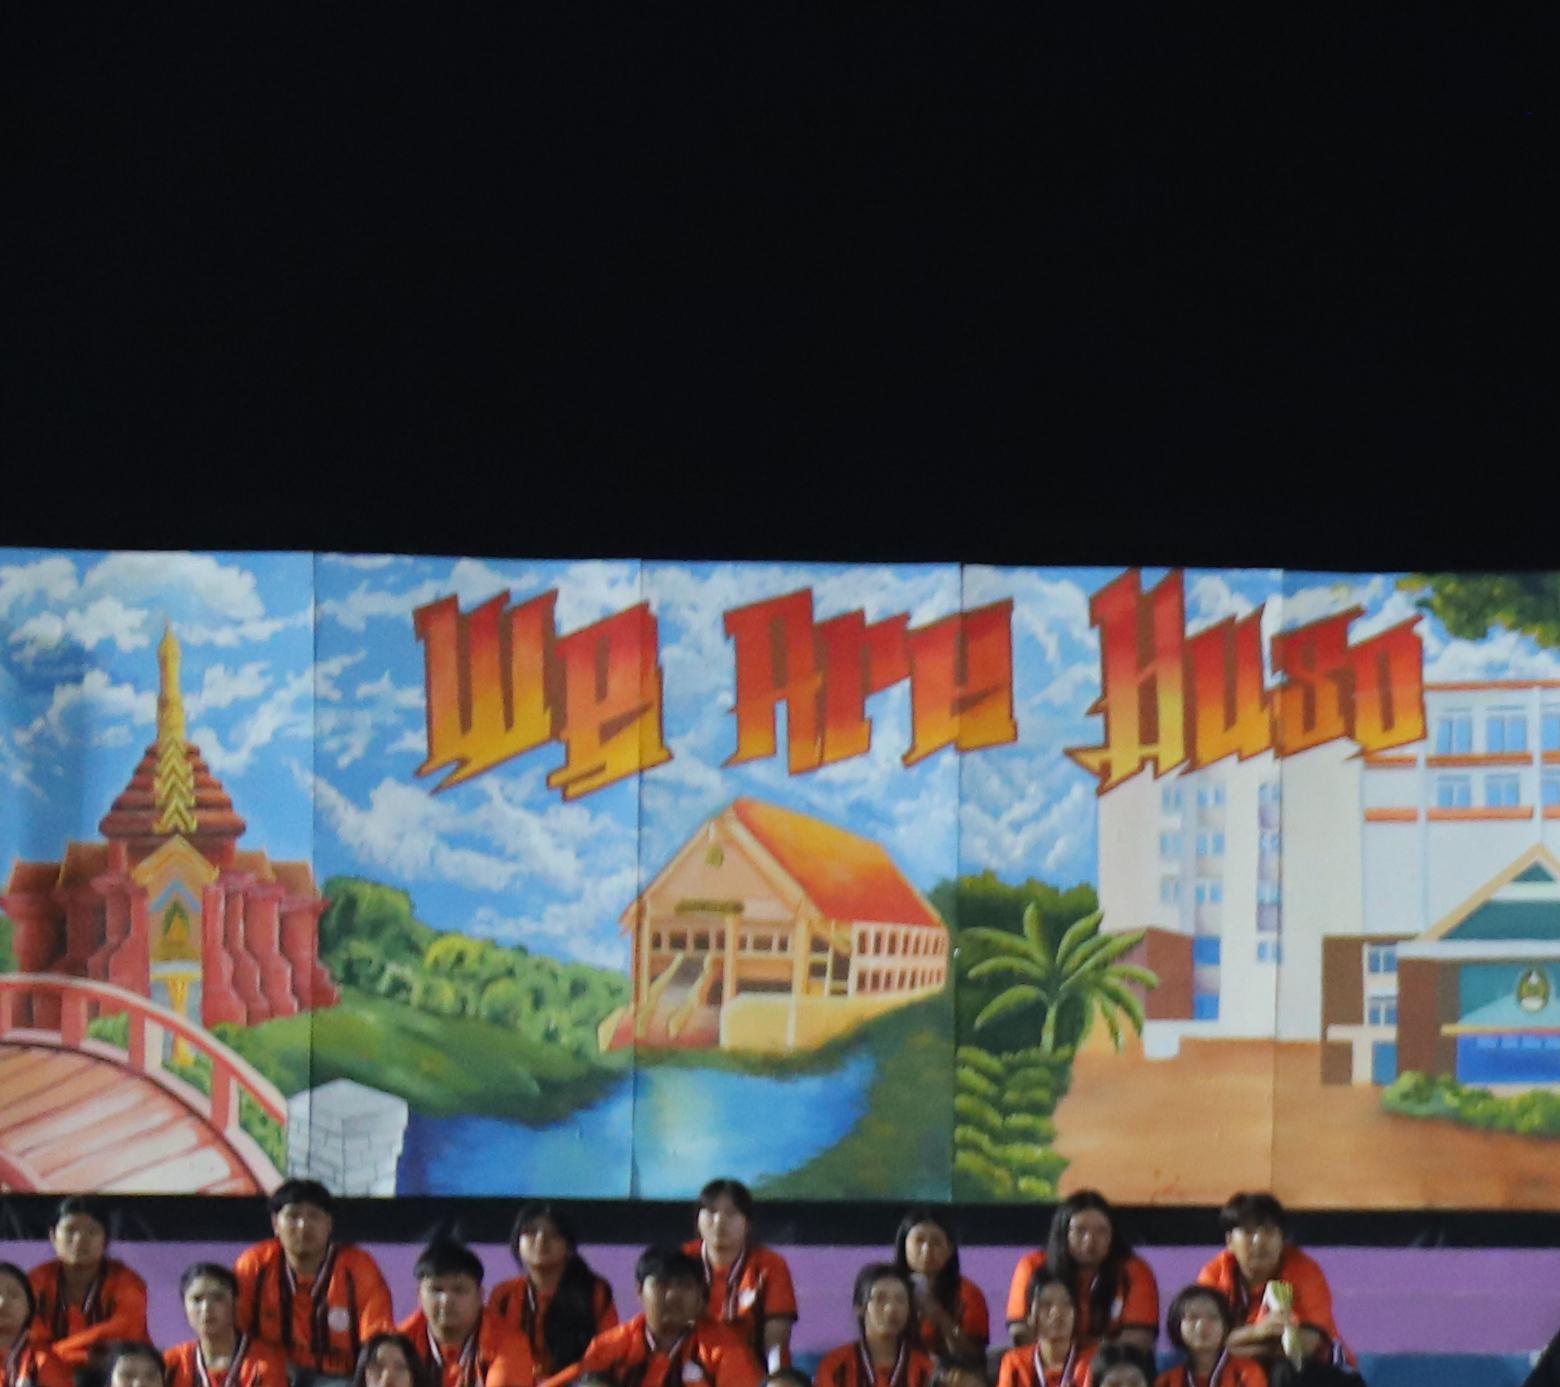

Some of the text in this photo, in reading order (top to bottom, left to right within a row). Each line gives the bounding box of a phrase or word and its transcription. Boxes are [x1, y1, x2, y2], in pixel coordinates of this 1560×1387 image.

[414, 567, 1427, 799] We Are Huso
